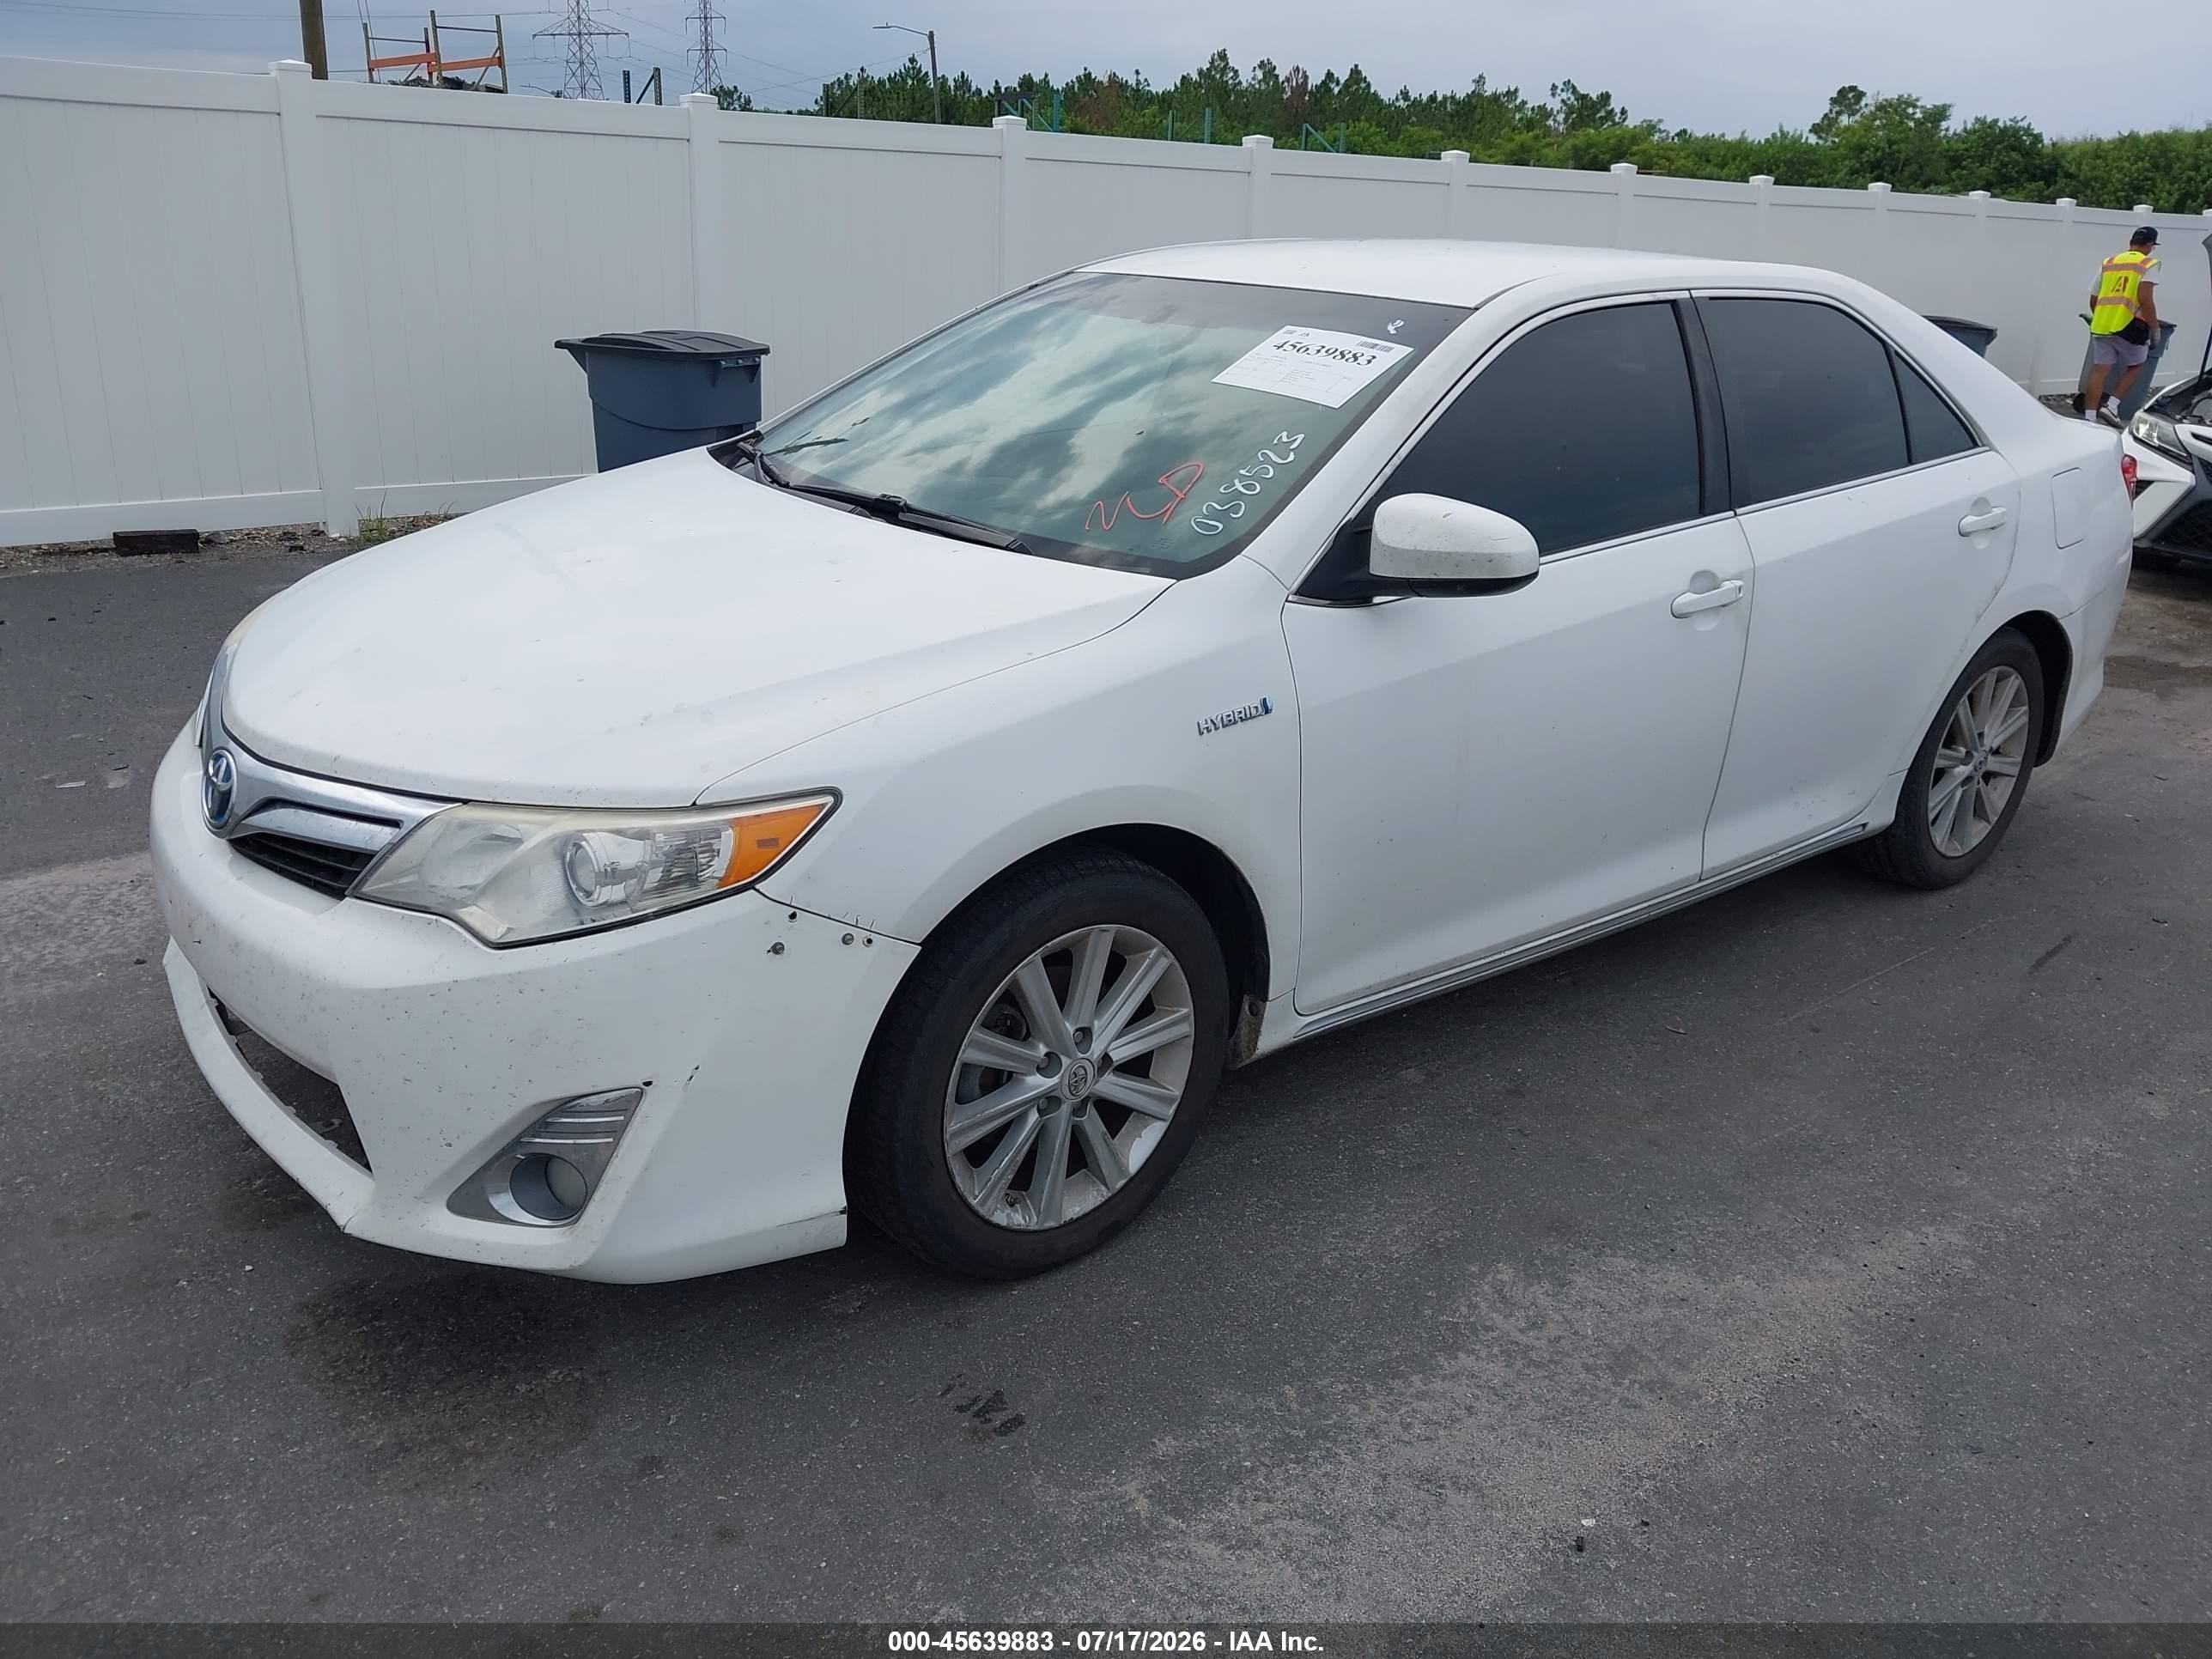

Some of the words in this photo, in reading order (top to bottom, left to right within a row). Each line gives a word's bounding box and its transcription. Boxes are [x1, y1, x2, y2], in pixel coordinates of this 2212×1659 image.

[1273, 340, 1377, 367] 45639883
[1190, 430, 1305, 535] 038523
[1196, 702, 1264, 736] HYBRID
